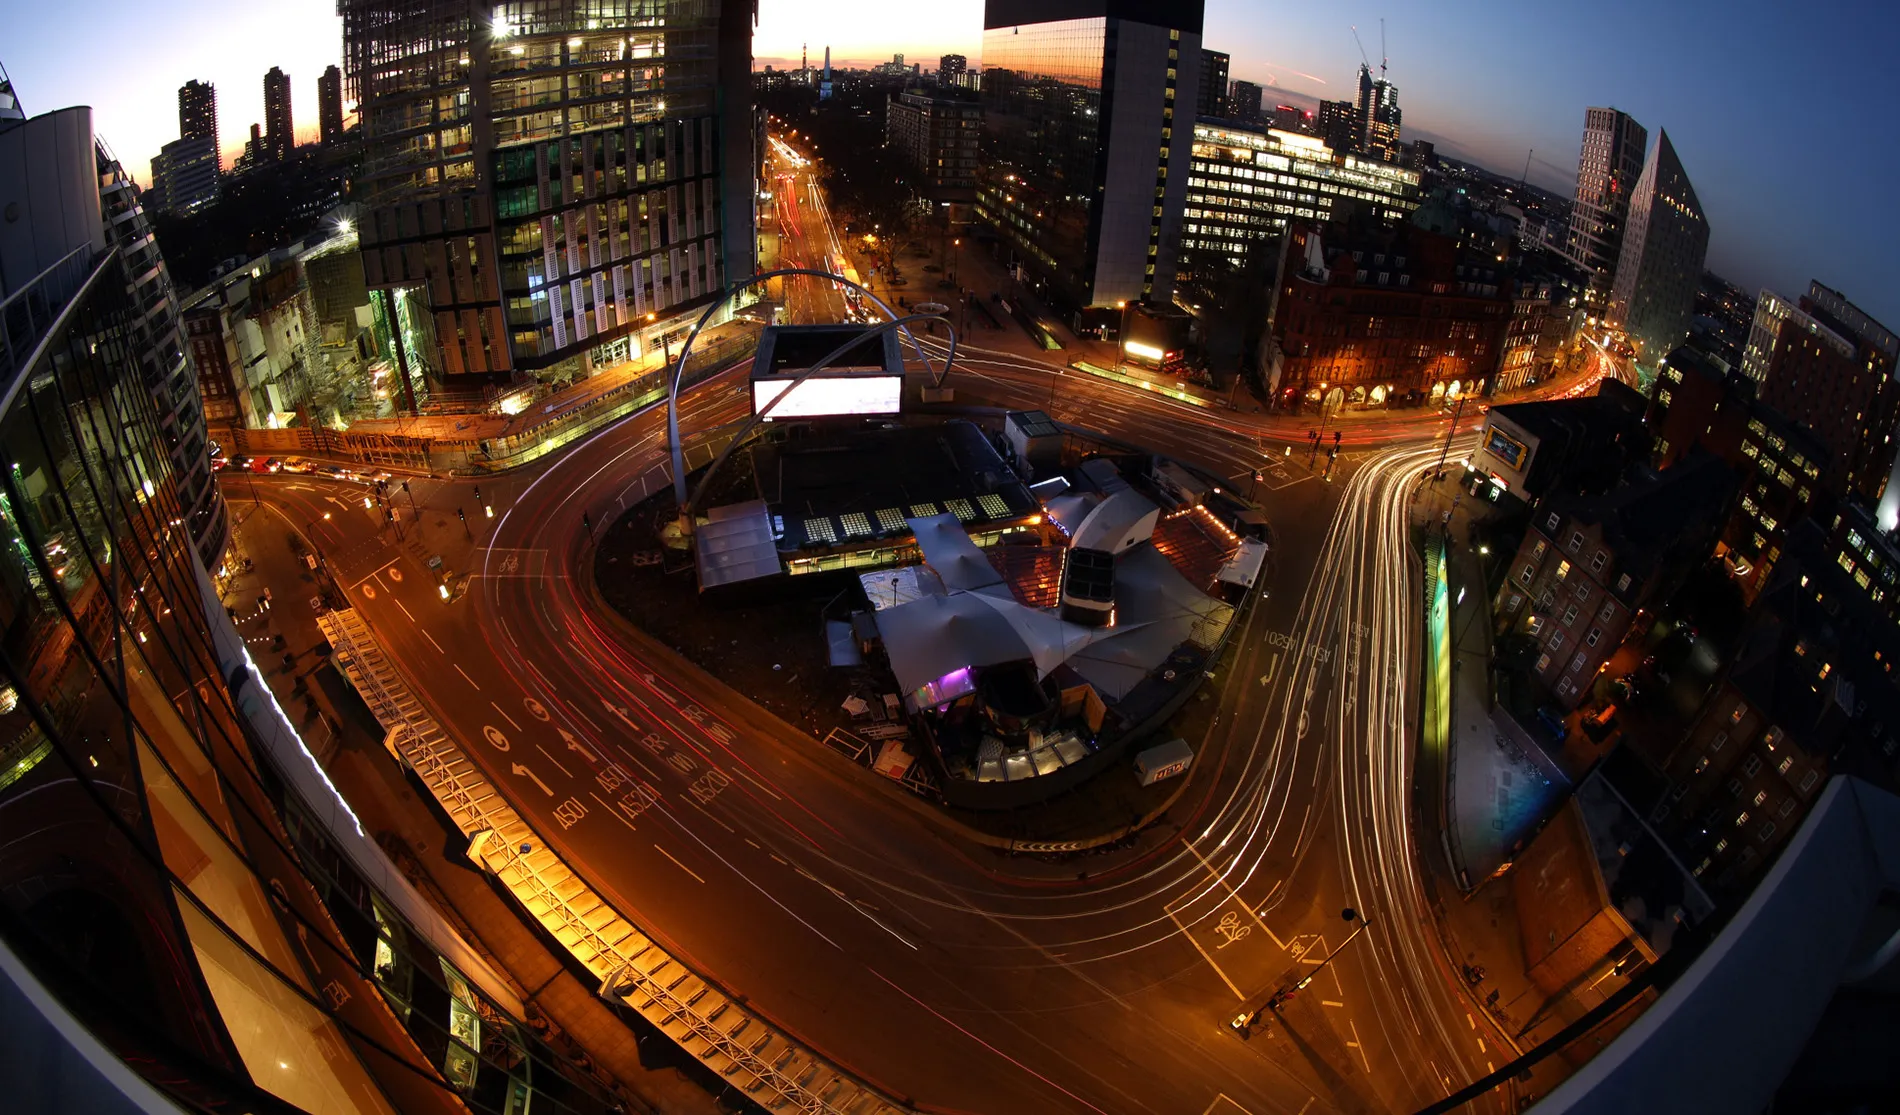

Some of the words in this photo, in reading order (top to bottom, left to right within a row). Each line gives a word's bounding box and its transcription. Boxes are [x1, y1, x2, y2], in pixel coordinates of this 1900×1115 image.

[1265, 631, 1297, 650] A5201
[1307, 642, 1331, 664] A501
[641, 733, 670, 756] RR
[595, 762, 632, 794] A501
[688, 769, 734, 805] A5201
[552, 796, 589, 831] A501
[617, 780, 662, 820] A5201
